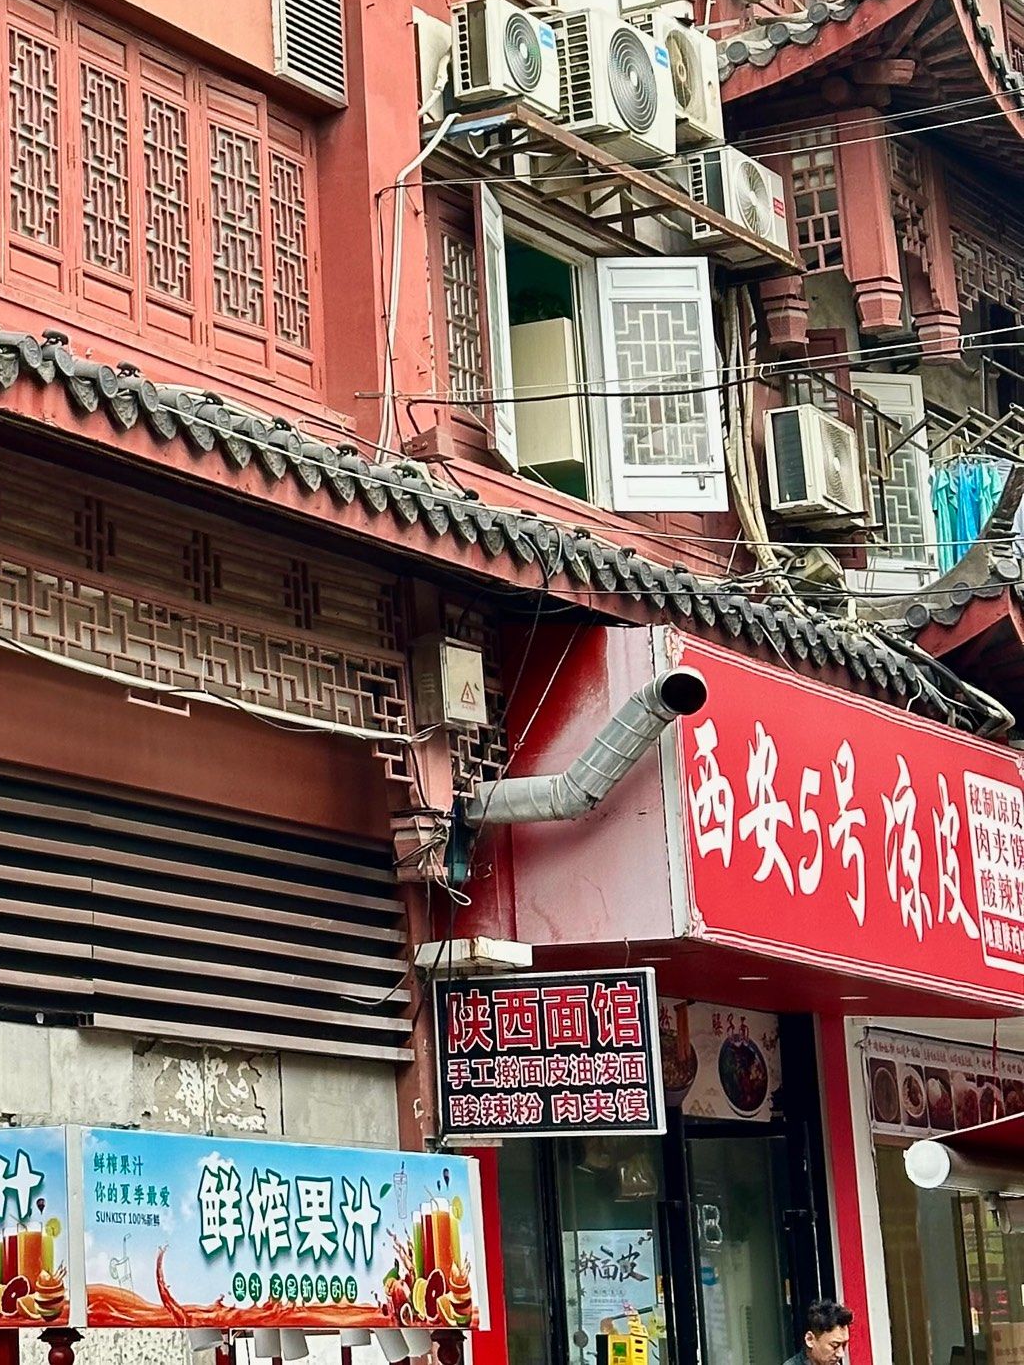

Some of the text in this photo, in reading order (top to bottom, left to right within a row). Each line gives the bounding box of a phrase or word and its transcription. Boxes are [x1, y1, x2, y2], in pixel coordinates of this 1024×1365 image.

[969, 783, 1023, 829] 秘制凉皮
[688, 718, 980, 942] 西安5号凉皮
[447, 981, 642, 1053] 陕西面馆
[447, 1052, 647, 1090] 手工擀面皮油泼面
[449, 1088, 650, 1126] 酸辣粉 肉夹馍
[93, 1152, 144, 1176] 鲜榨果汁
[95, 1181, 170, 1208] 你的夏季最爱
[95, 1210, 127, 1224] SUNKIST
[198, 1165, 381, 1266] 鲜榨果汁
